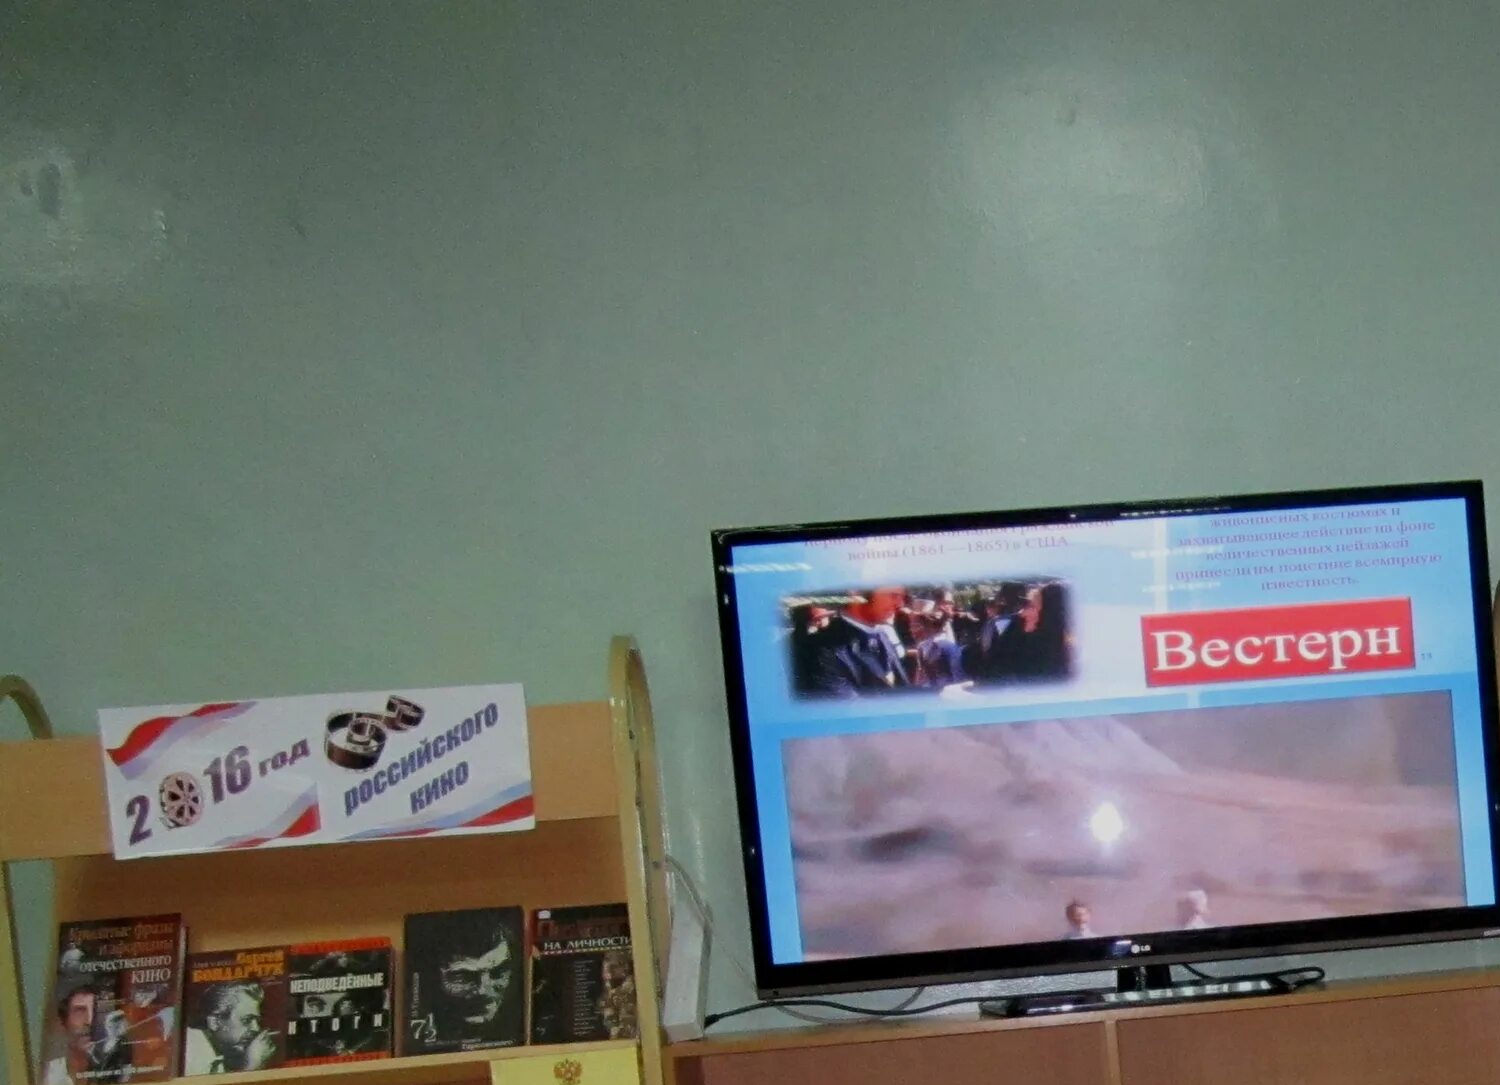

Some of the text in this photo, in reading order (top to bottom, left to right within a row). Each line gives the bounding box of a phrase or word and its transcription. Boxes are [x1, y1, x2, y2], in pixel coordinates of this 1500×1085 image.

[1312, 508, 1387, 524] костюмах
[1300, 526, 1371, 541] действие
[1396, 519, 1437, 536] фоне
[1024, 535, 1069, 551] США
[1354, 553, 1443, 569] всемирную
[1149, 625, 1403, 672] Вестерн
[258, 738, 311, 778] год
[544, 941, 562, 952] НА
[289, 972, 385, 994] НЕПОДВЕДЁННЫЕ
